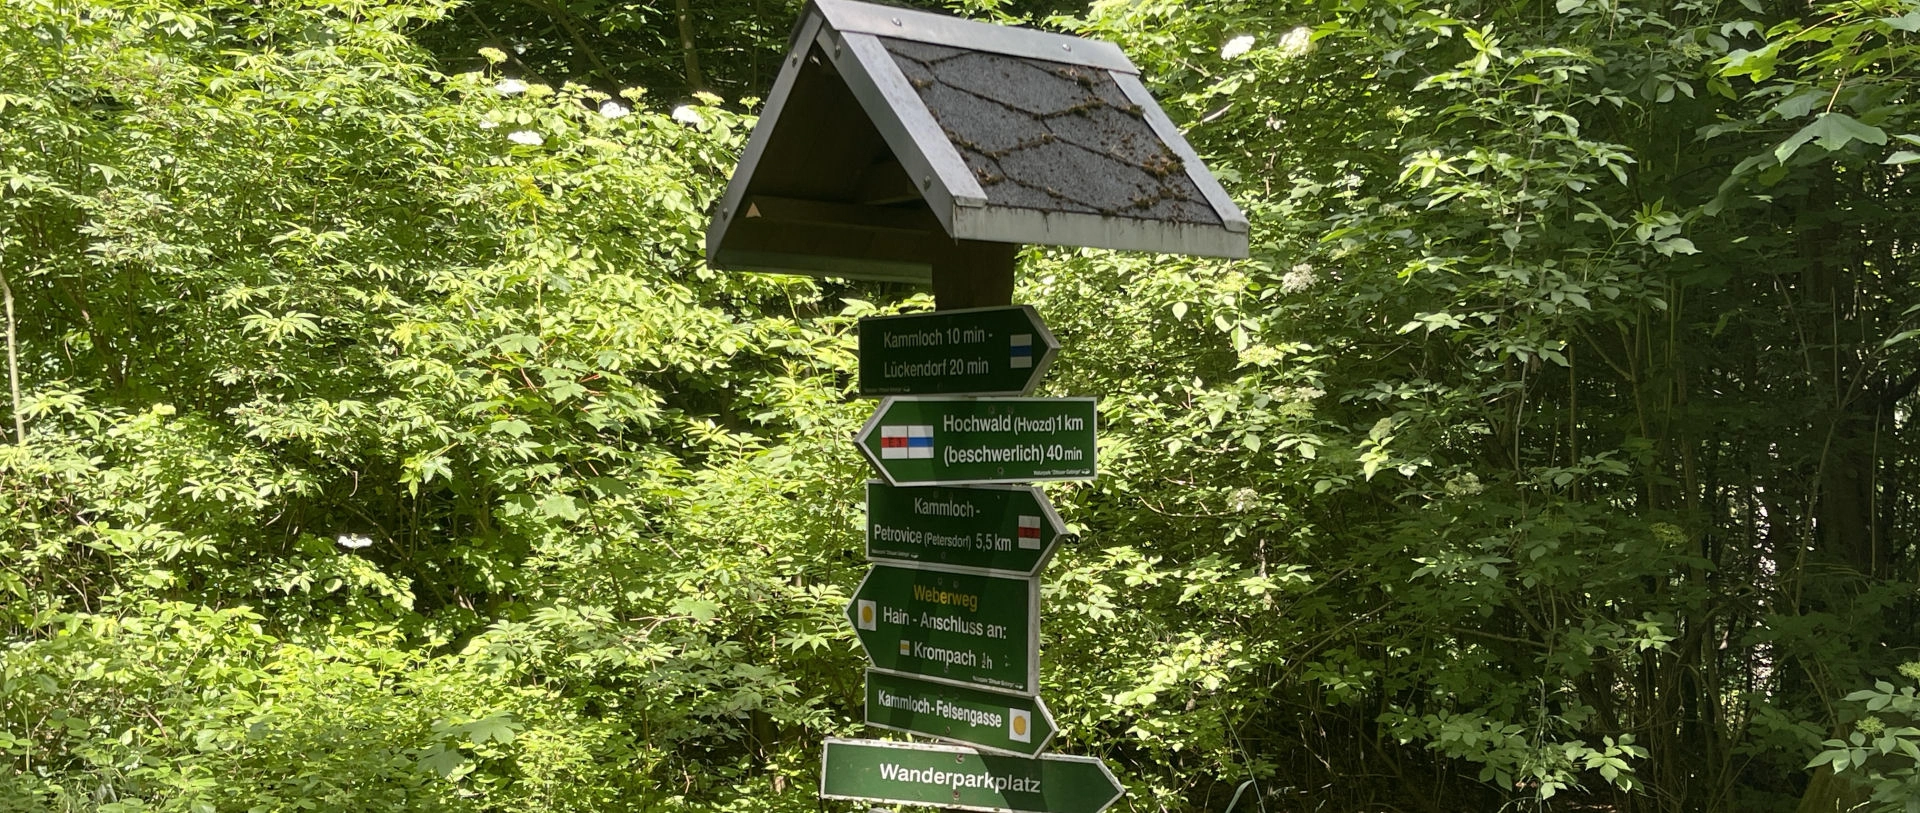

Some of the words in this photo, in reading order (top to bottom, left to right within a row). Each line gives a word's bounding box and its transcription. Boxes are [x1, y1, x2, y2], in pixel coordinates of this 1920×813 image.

[884, 329, 943, 348] Kammloch
[947, 328, 960, 345] 10
[963, 327, 985, 344] min
[884, 357, 947, 378] Lückendorf
[950, 358, 963, 375] 20
[967, 357, 989, 375] min
[943, 414, 1011, 432] Hochwald
[1014, 416, 1055, 435] (Hvozd)
[1065, 414, 1083, 431] km
[944, 445, 1044, 467] (beschwerlich)
[1046, 445, 1063, 461] 40
[1064, 448, 1083, 461] min
[874, 523, 923, 544] Petrovice
[924, 533, 971, 551] (Petersdorf)
[976, 533, 992, 551] 5,5
[995, 534, 1012, 552] km
[914, 584, 978, 612] Weberweg
[883, 606, 910, 626] Hain
[920, 611, 984, 636] Anschluss
[987, 624, 1008, 640] an:
[914, 641, 976, 667] Krompach
[880, 762, 1041, 794] Wanderparkplatz
